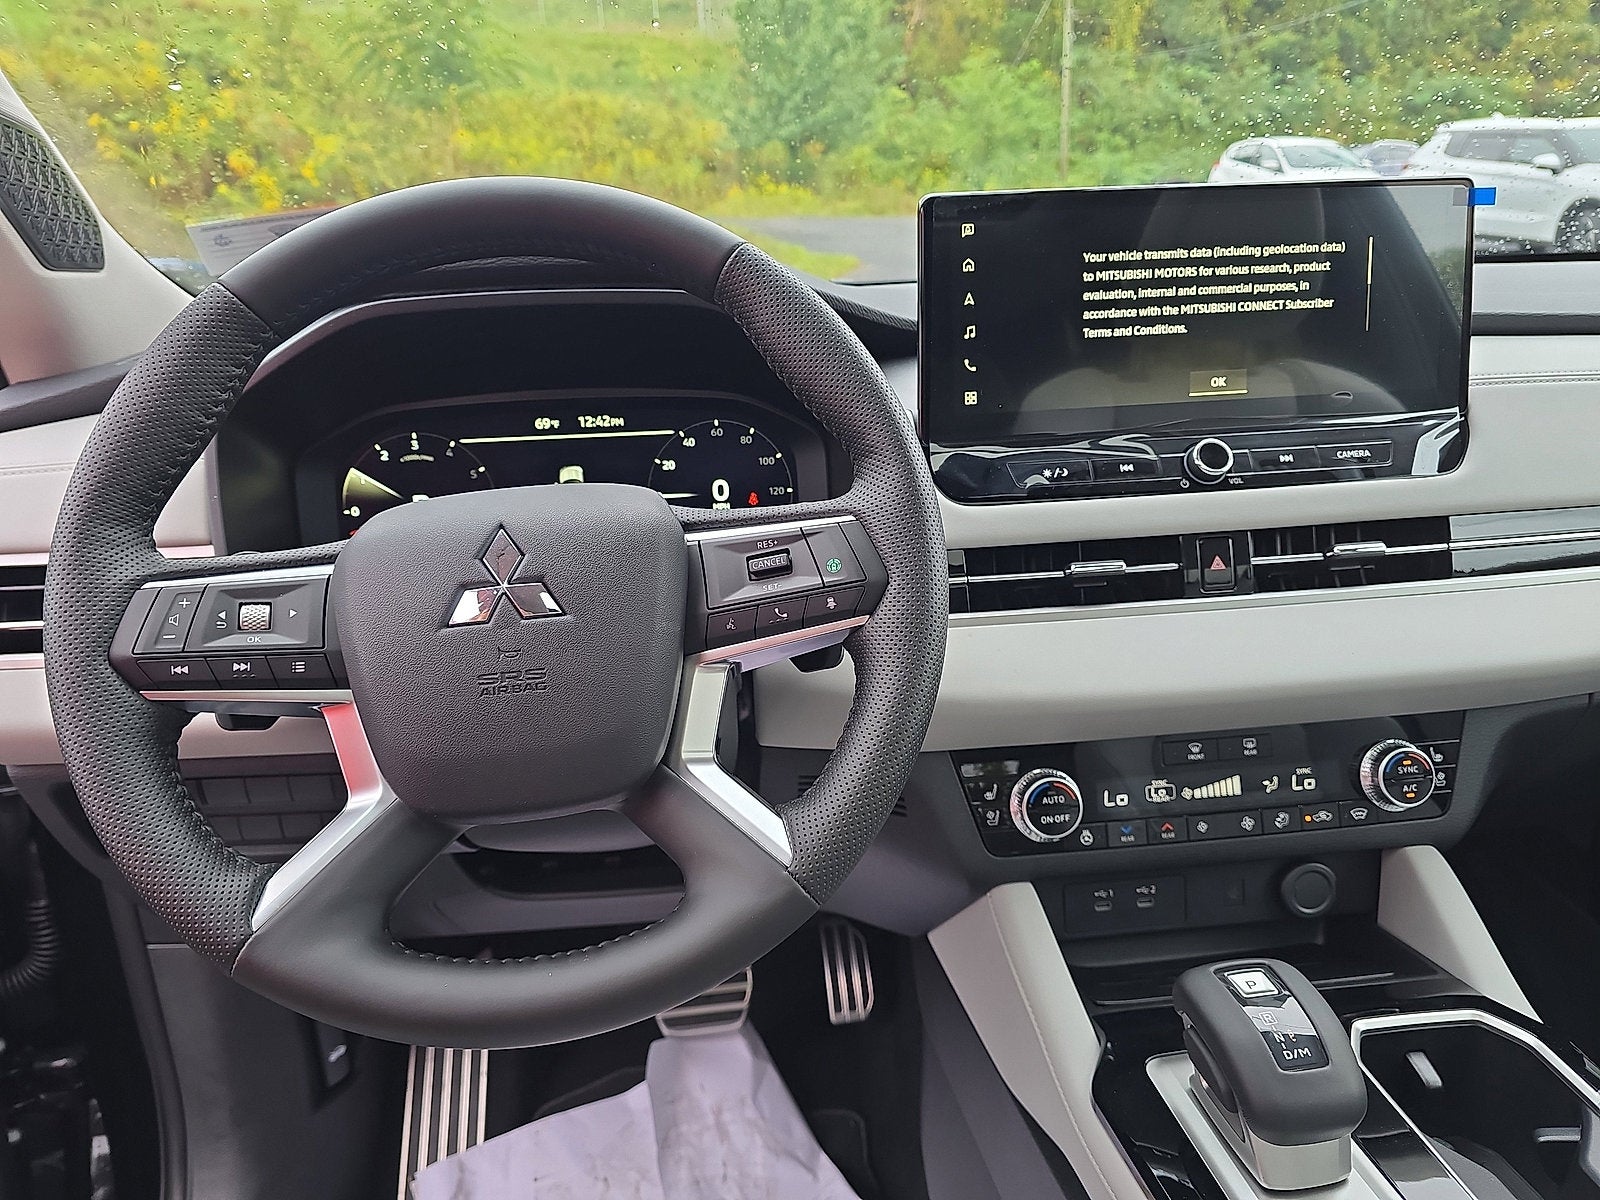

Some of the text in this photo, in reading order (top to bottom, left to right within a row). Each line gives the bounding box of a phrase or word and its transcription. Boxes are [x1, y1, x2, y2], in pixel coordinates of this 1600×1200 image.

[1083, 242, 1346, 262] Your vehicle transmits data (including geolocation data)
[1083, 261, 1331, 282] to MITSUBISHI MOTORS for various research, product
[1083, 280, 1310, 300] evaluation, internal and commercial purposes, in
[1083, 298, 1334, 319] accordance with the MITSUBISHI CONNECT Subscriber
[1083, 324, 1188, 338] Terms and Conditions.
[1210, 376, 1226, 388] OK
[710, 427, 723, 437] 60
[410, 439, 419, 450] 3
[682, 437, 696, 447] 40
[740, 435, 753, 445] 80
[380, 449, 390, 462] 2
[1336, 449, 1372, 460] CAMERA
[661, 460, 676, 471] 20
[758, 456, 776, 466] 100
[1228, 477, 1244, 485] VOL
[711, 478, 730, 502] 0
[769, 486, 785, 496] 120
[350, 505, 361, 518] 0
[751, 557, 787, 571] CANCEL
[478, 667, 548, 686] SRS
[480, 682, 548, 697] AIRBAG
[1397, 765, 1419, 774] SYNC
[1403, 783, 1418, 792] A/C
[1042, 794, 1066, 805] AUTO
[1245, 980, 1257, 990] P
[1273, 1031, 1286, 1043] N
[1282, 1047, 1312, 1061] D/M
